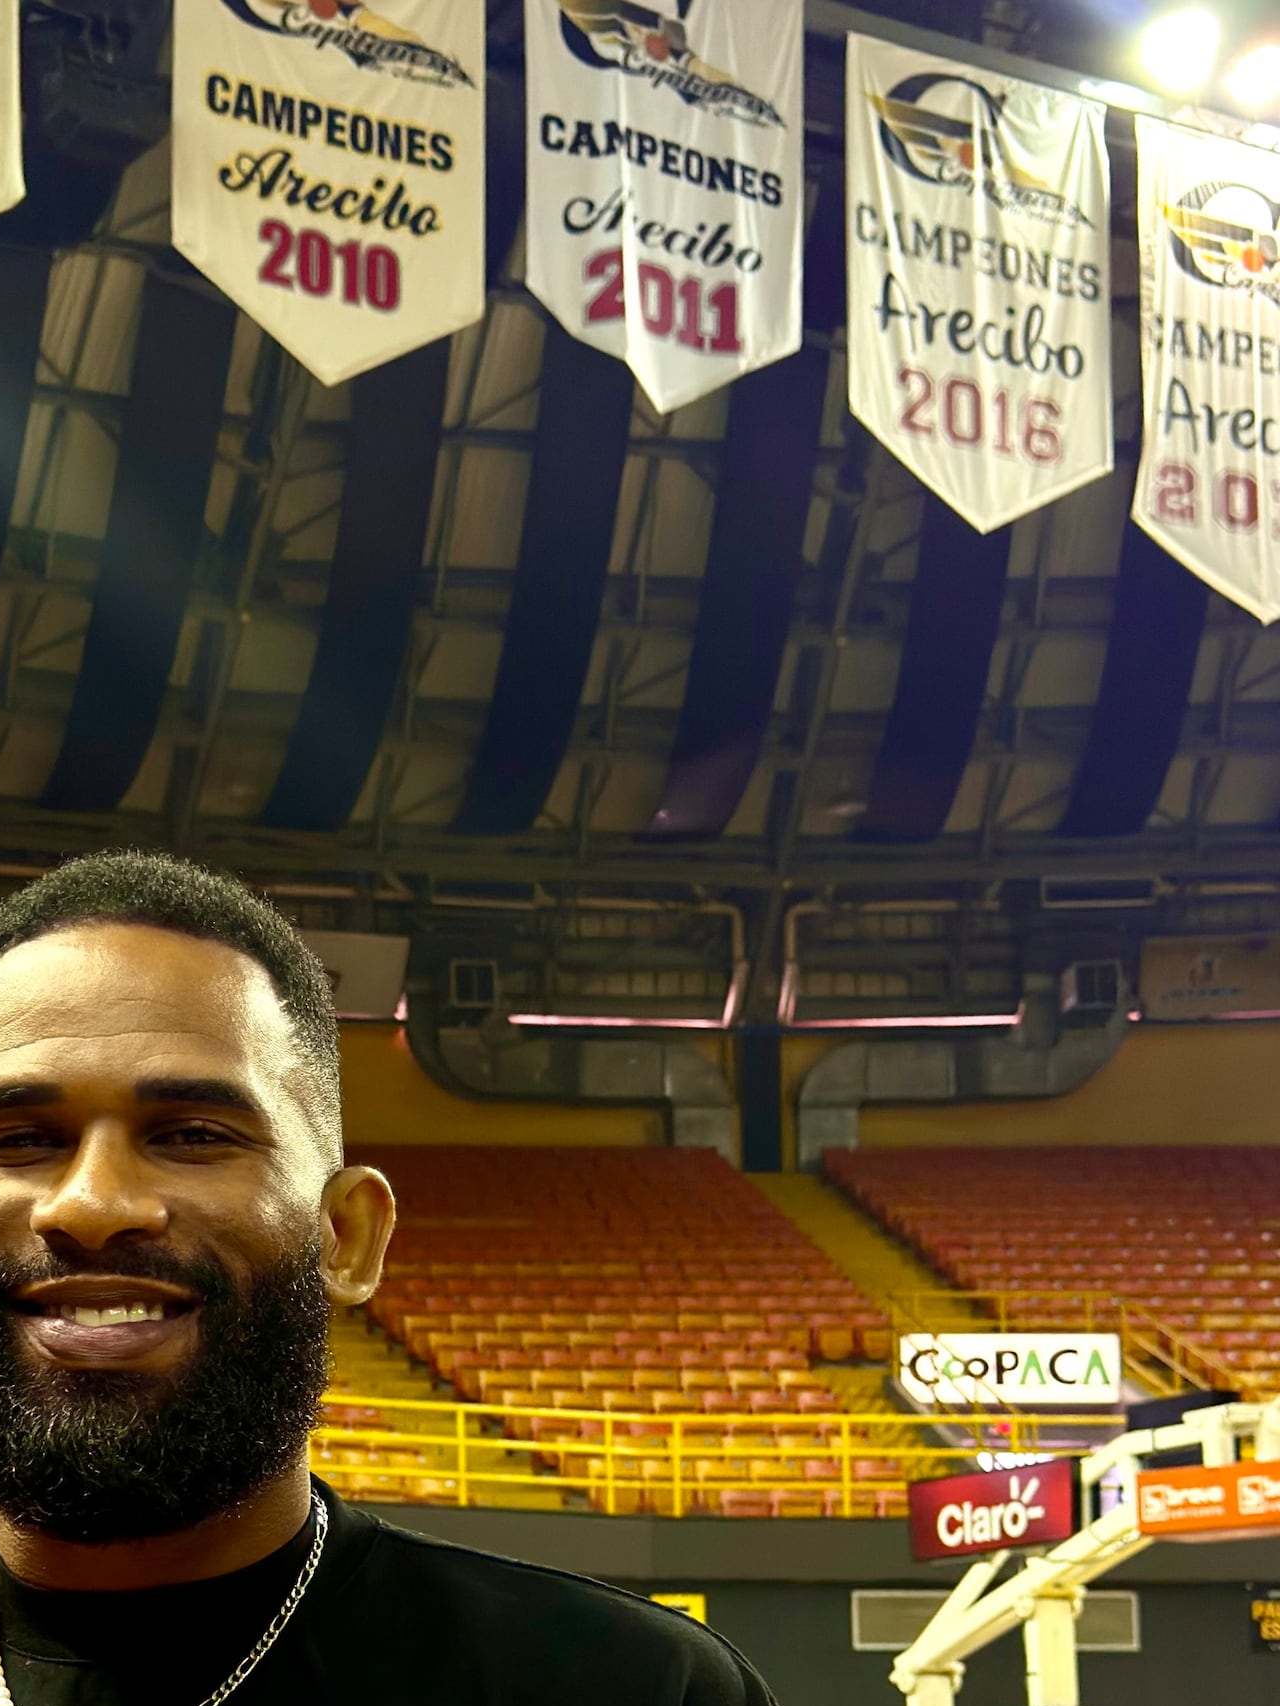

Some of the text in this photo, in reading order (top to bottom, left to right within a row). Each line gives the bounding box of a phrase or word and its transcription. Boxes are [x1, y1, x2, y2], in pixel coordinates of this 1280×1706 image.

[206, 73, 454, 173] CAMPEONES
[540, 114, 783, 208] CAMPEONES
[219, 149, 440, 236] Arecibo
[562, 188, 763, 273] Aecibo
[258, 216, 401, 312] 2010
[582, 246, 744, 355] 2011
[856, 203, 1101, 302] CAMPEONES
[872, 271, 1085, 380] Arecibo
[898, 365, 1067, 466] 2016
[1154, 462, 1280, 538] 20
[937, 1494, 1030, 1548] Claro
